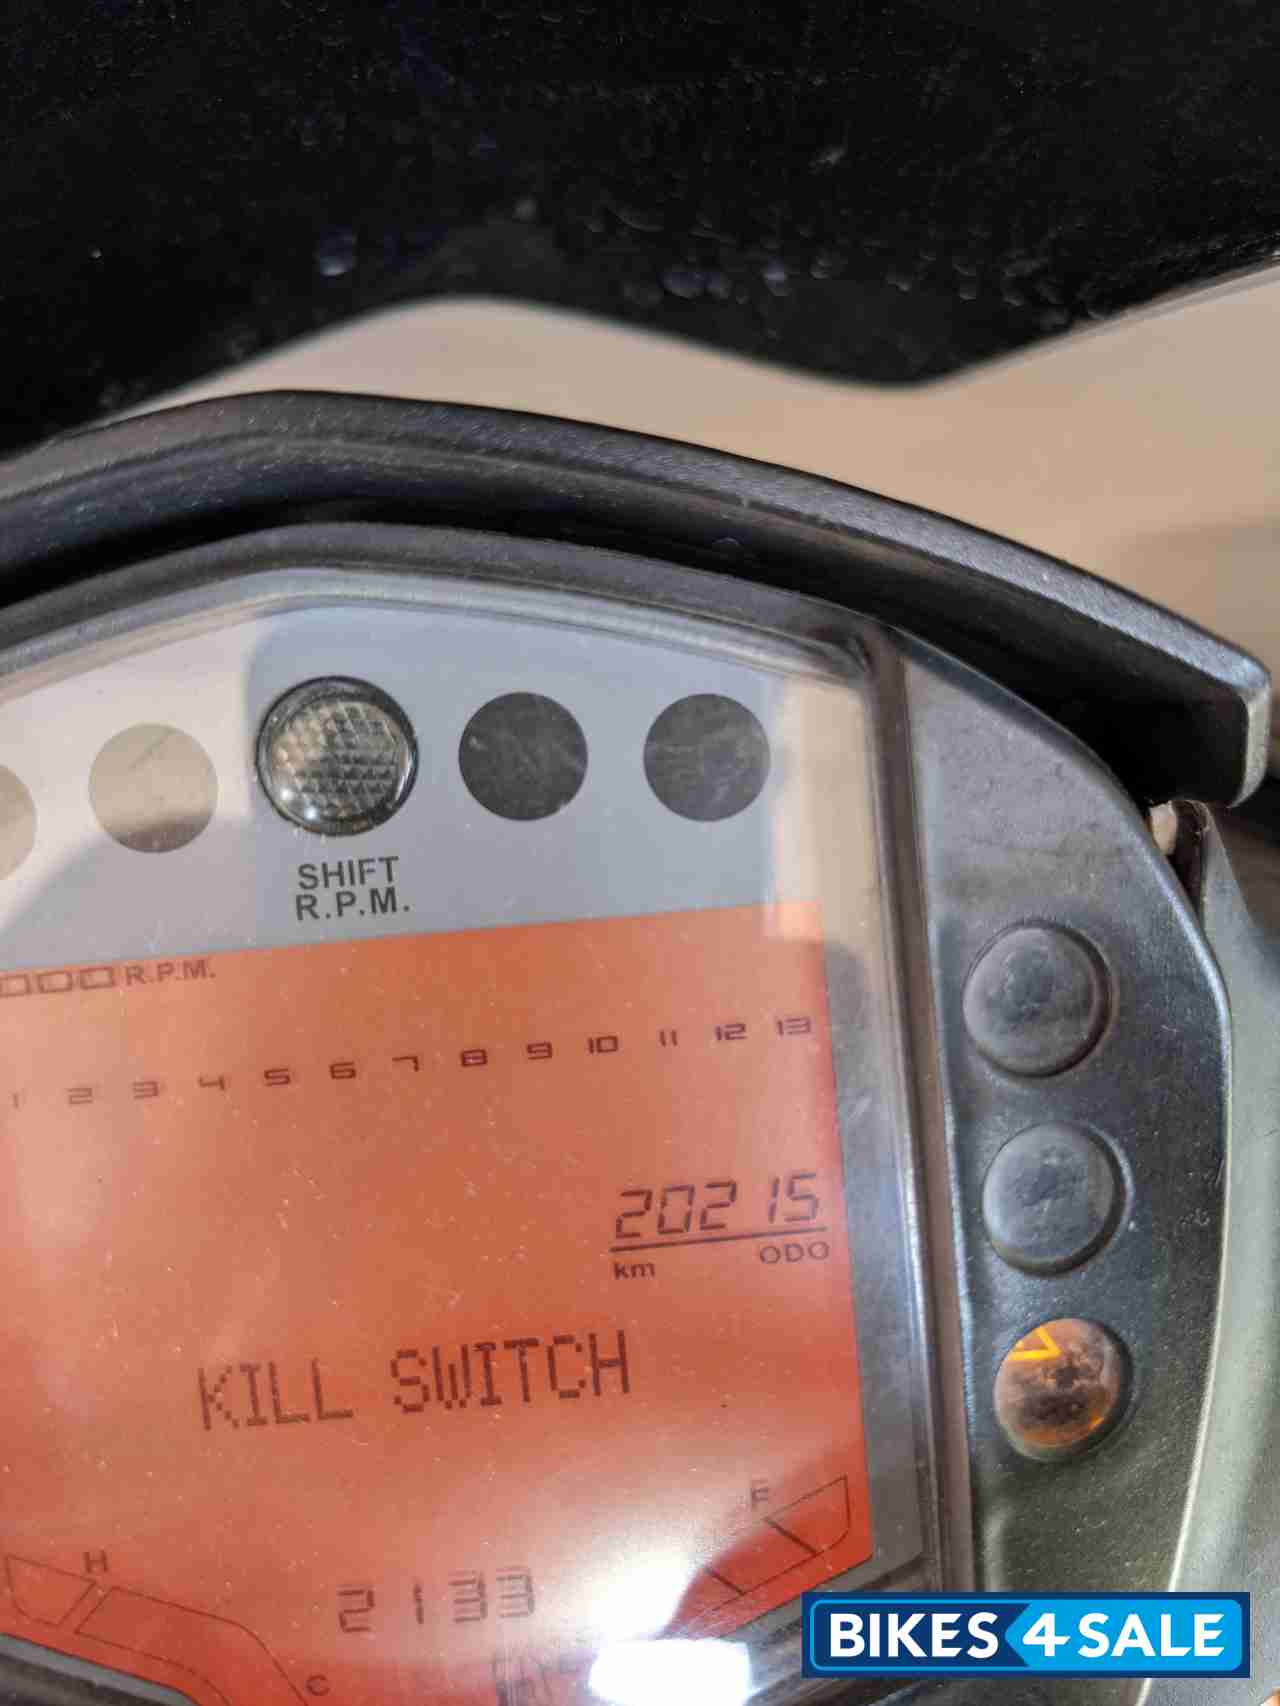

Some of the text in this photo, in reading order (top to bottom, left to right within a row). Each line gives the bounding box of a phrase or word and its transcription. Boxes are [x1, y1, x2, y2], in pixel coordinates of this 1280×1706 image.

[298, 857, 399, 890] SHIFT
[296, 888, 410, 920] R.P.M.
[124, 960, 216, 986] R.P.M.
[67, 1087, 93, 1105] 2
[132, 1081, 158, 1099] 3
[199, 1075, 225, 1091] 4
[264, 1068, 291, 1086] 5
[329, 1062, 356, 1080] 6
[460, 1049, 488, 1067] 8
[526, 1042, 553, 1060] 9
[588, 1035, 619, 1054] 10
[659, 1030, 678, 1048] 11
[715, 1023, 747, 1041] 12
[776, 1016, 811, 1036] 13
[615, 1173, 819, 1239] 20215
[613, 1241, 830, 1279] km ODO
[199, 1330, 630, 1430] KILL SWITCH
[84, 1550, 109, 1573] H
[306, 1674, 330, 1697] C
